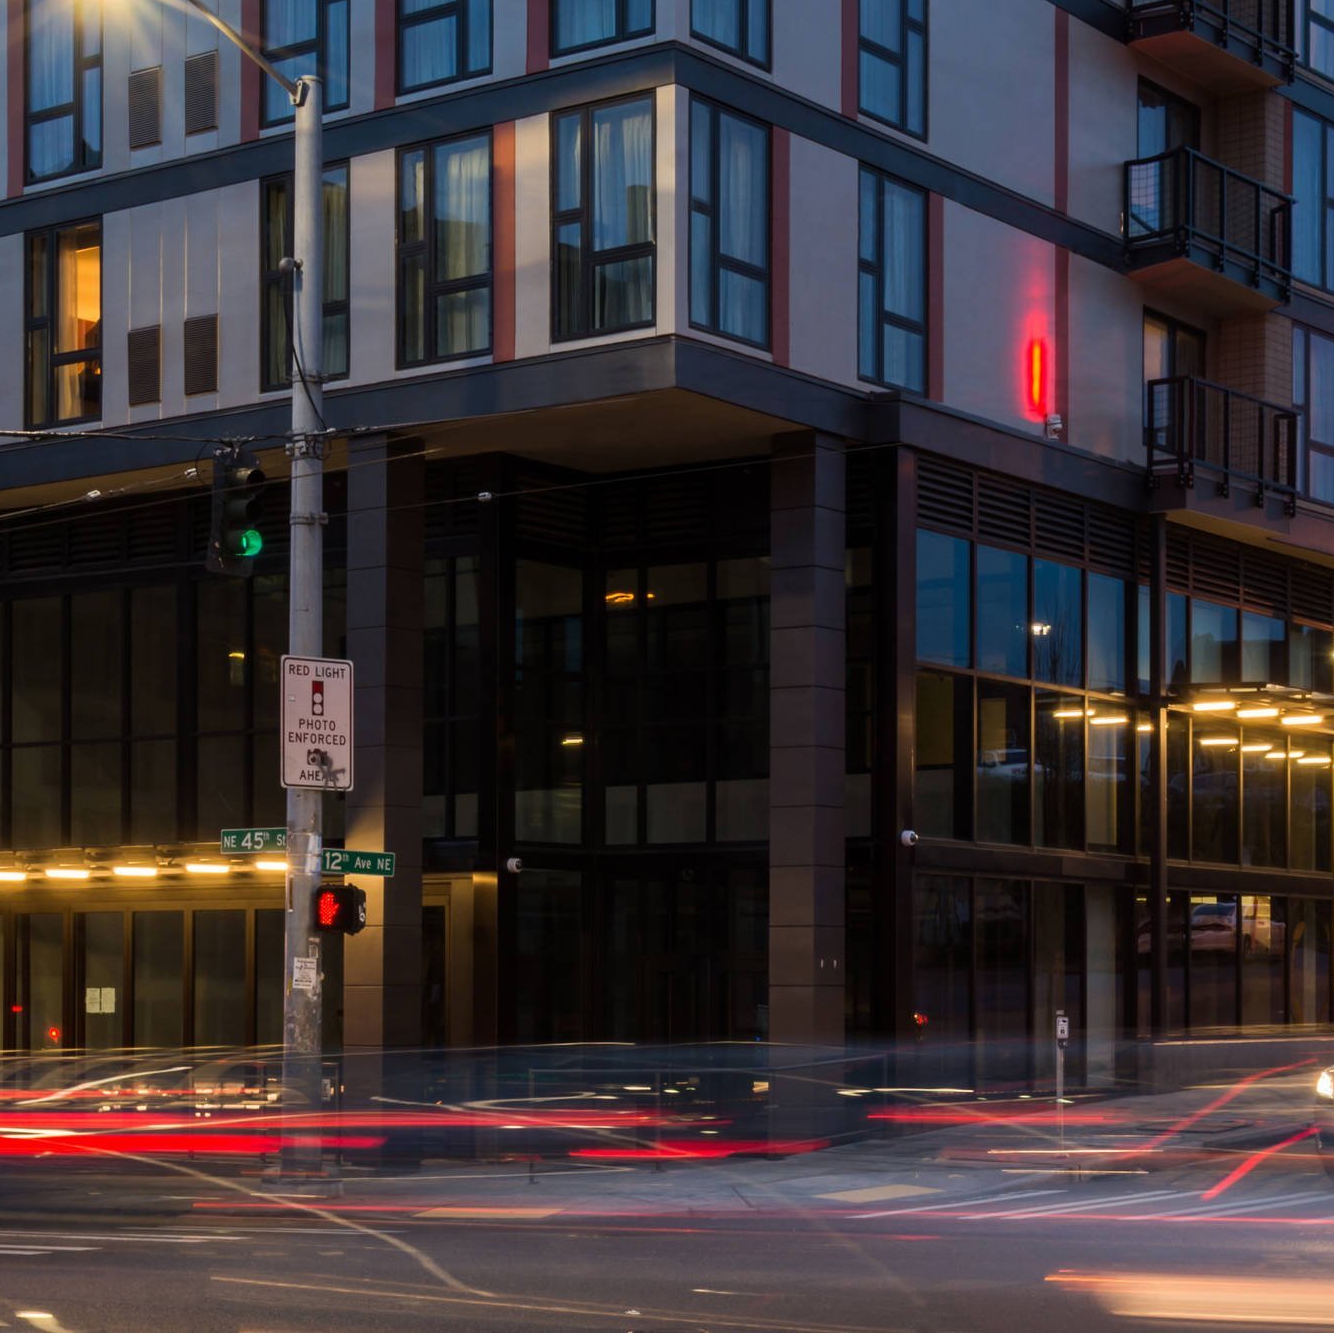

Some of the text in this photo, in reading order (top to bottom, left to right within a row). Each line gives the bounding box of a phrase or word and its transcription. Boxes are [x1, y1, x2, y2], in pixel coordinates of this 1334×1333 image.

[288, 664, 346, 679] RED LIGHT
[298, 718, 336, 732] PHOTO
[288, 731, 346, 746] ENFORCED
[299, 769, 339, 783] AHE
[223, 831, 286, 850] NE 45th St
[325, 852, 391, 871] 12th Ave NE
